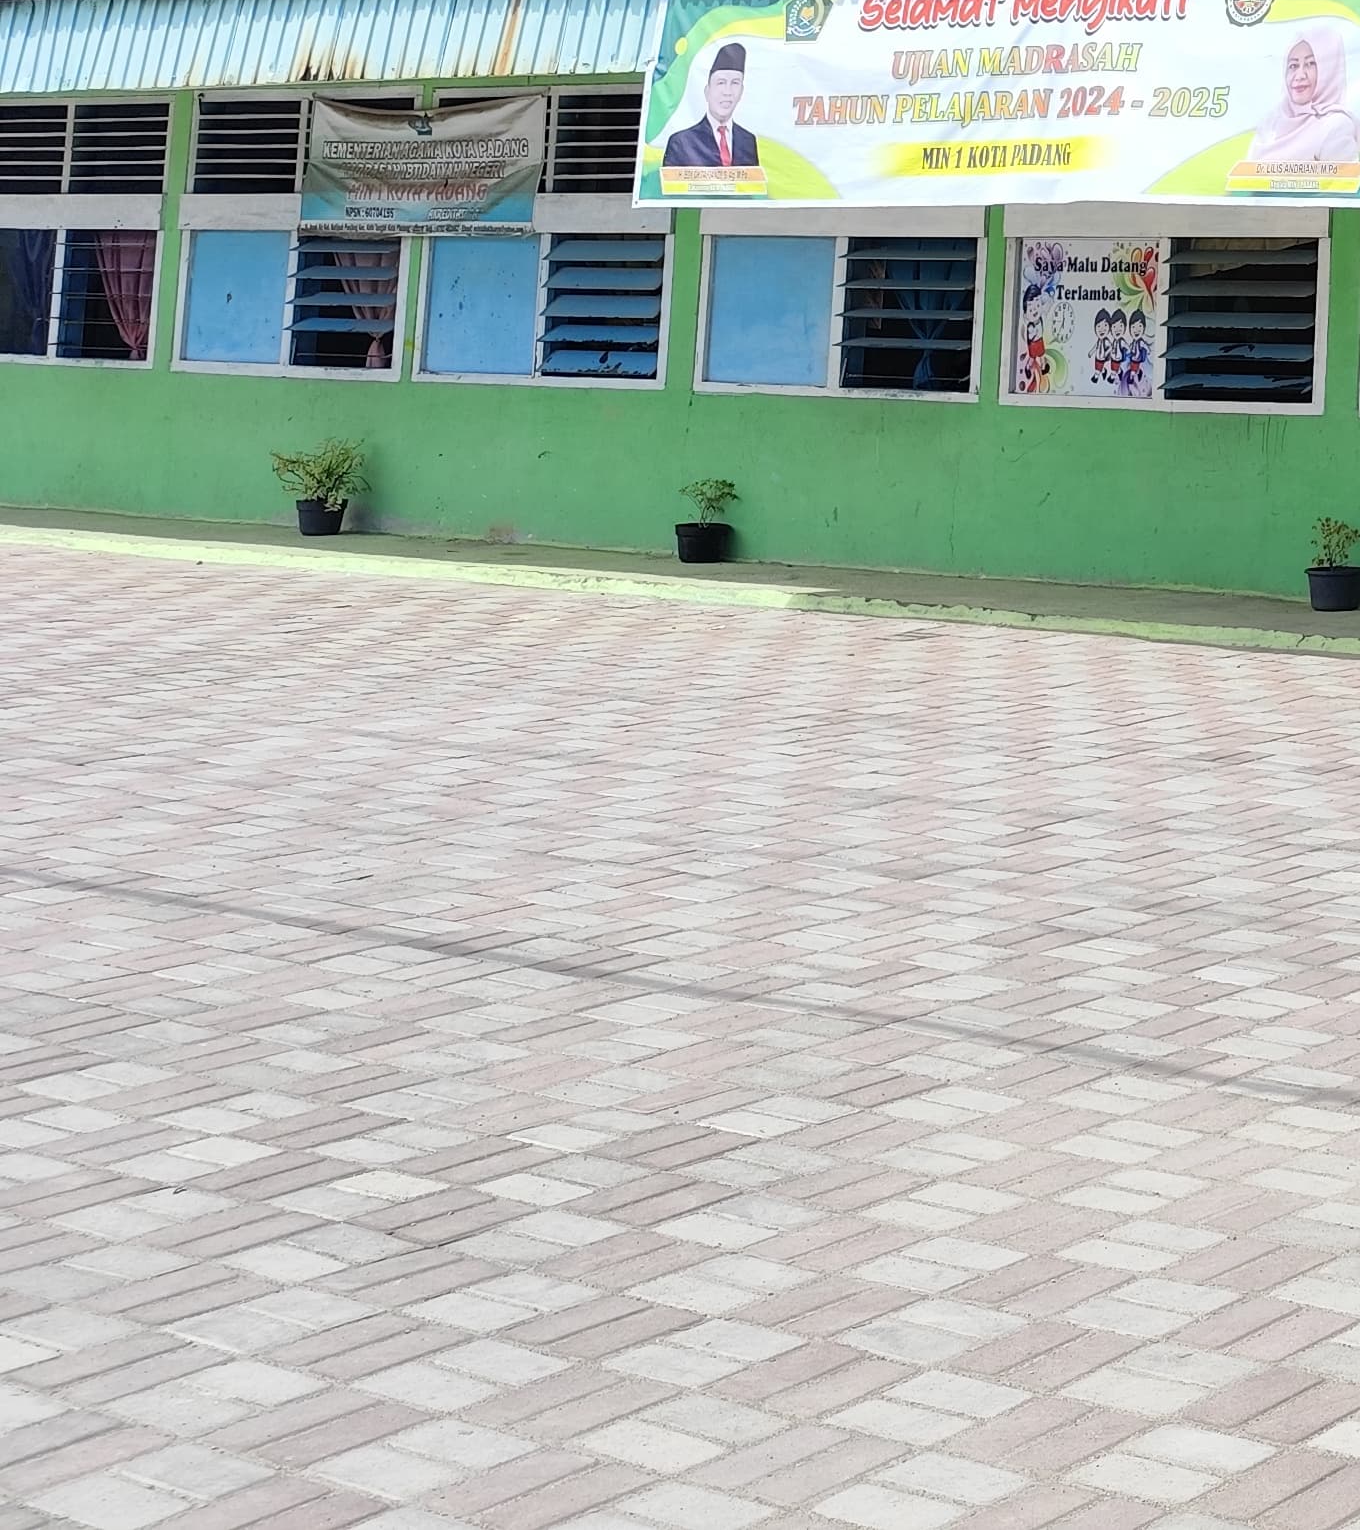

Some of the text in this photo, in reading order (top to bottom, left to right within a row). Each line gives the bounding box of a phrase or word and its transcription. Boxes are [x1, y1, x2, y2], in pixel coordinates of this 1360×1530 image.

[891, 41, 1144, 83] UJIAN MADRASAH
[792, 94, 889, 126] TAHUN
[893, 88, 1053, 128] PELAJARAN
[1056, 85, 1125, 118] 2024
[1149, 86, 1231, 118] 2025
[322, 137, 529, 160] KEMENTERIAN AGAMA KOTA PADANG
[921, 142, 1071, 170] MIN 1 KOTA PADANG
[401, 161, 462, 180] IBTIDAIYAH
[463, 159, 506, 179] NEGERI
[386, 182, 426, 202] KOTA
[427, 181, 489, 202] PADANG
[1034, 256, 1148, 276] Saya Malu Datang
[1056, 284, 1123, 301] Terlambat
